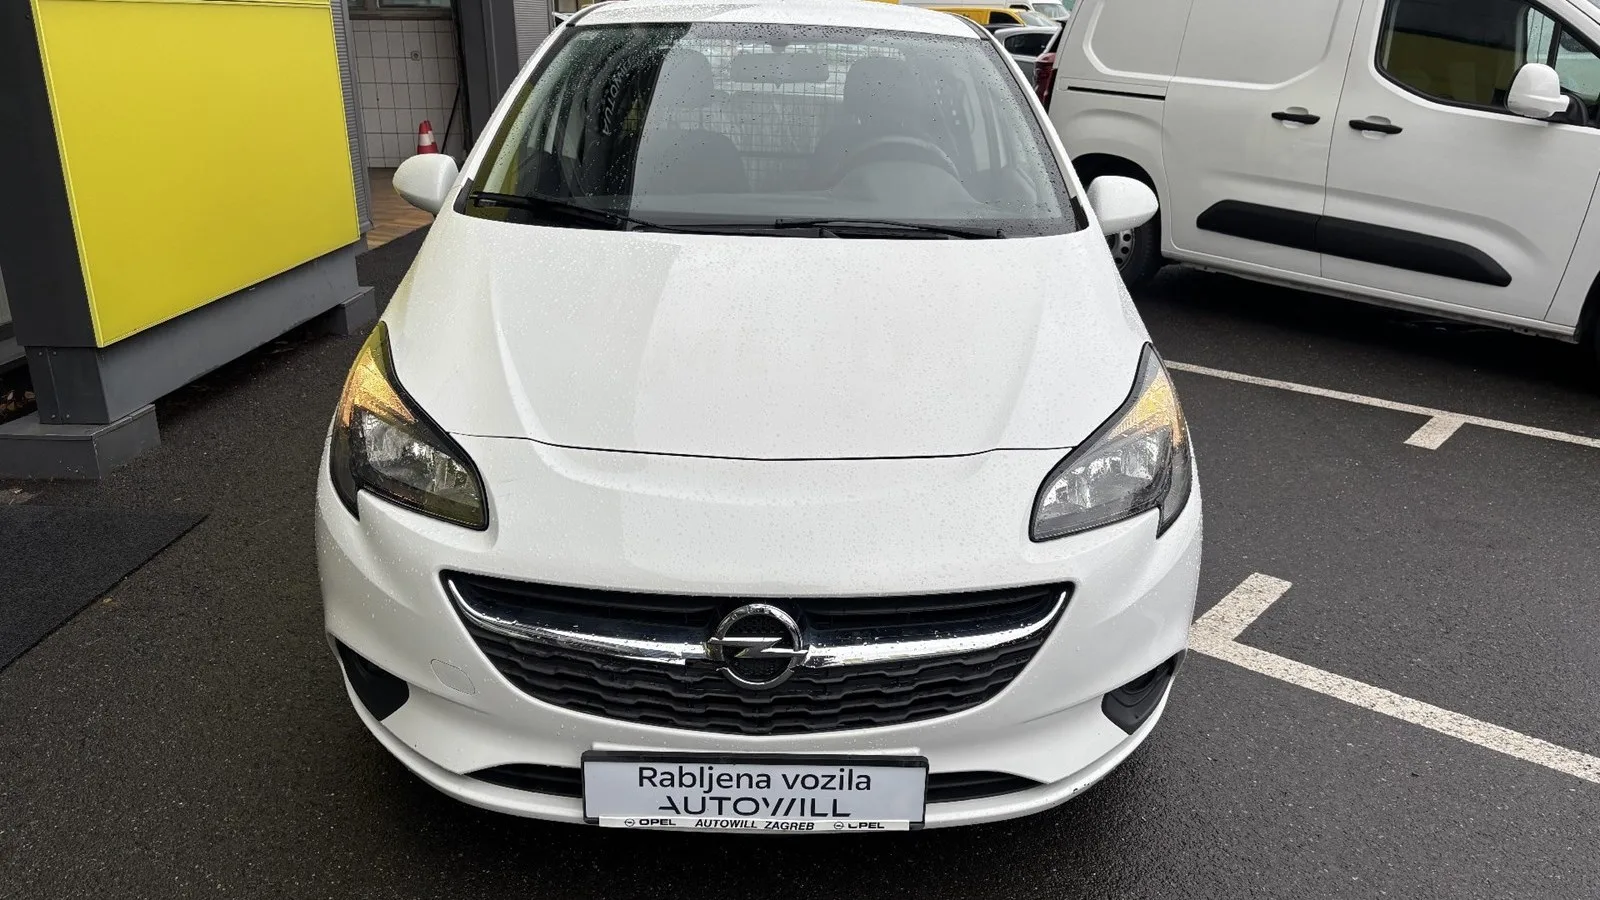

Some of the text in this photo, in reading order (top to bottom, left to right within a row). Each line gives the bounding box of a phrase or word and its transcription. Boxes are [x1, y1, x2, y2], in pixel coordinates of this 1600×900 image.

[638, 766, 872, 792] Rabljena vozila
[658, 796, 851, 817] AUTOWILL
[638, 818, 676, 826] OPEL
[694, 819, 758, 829] AUTOWILL
[764, 820, 815, 831] ZAGREB
